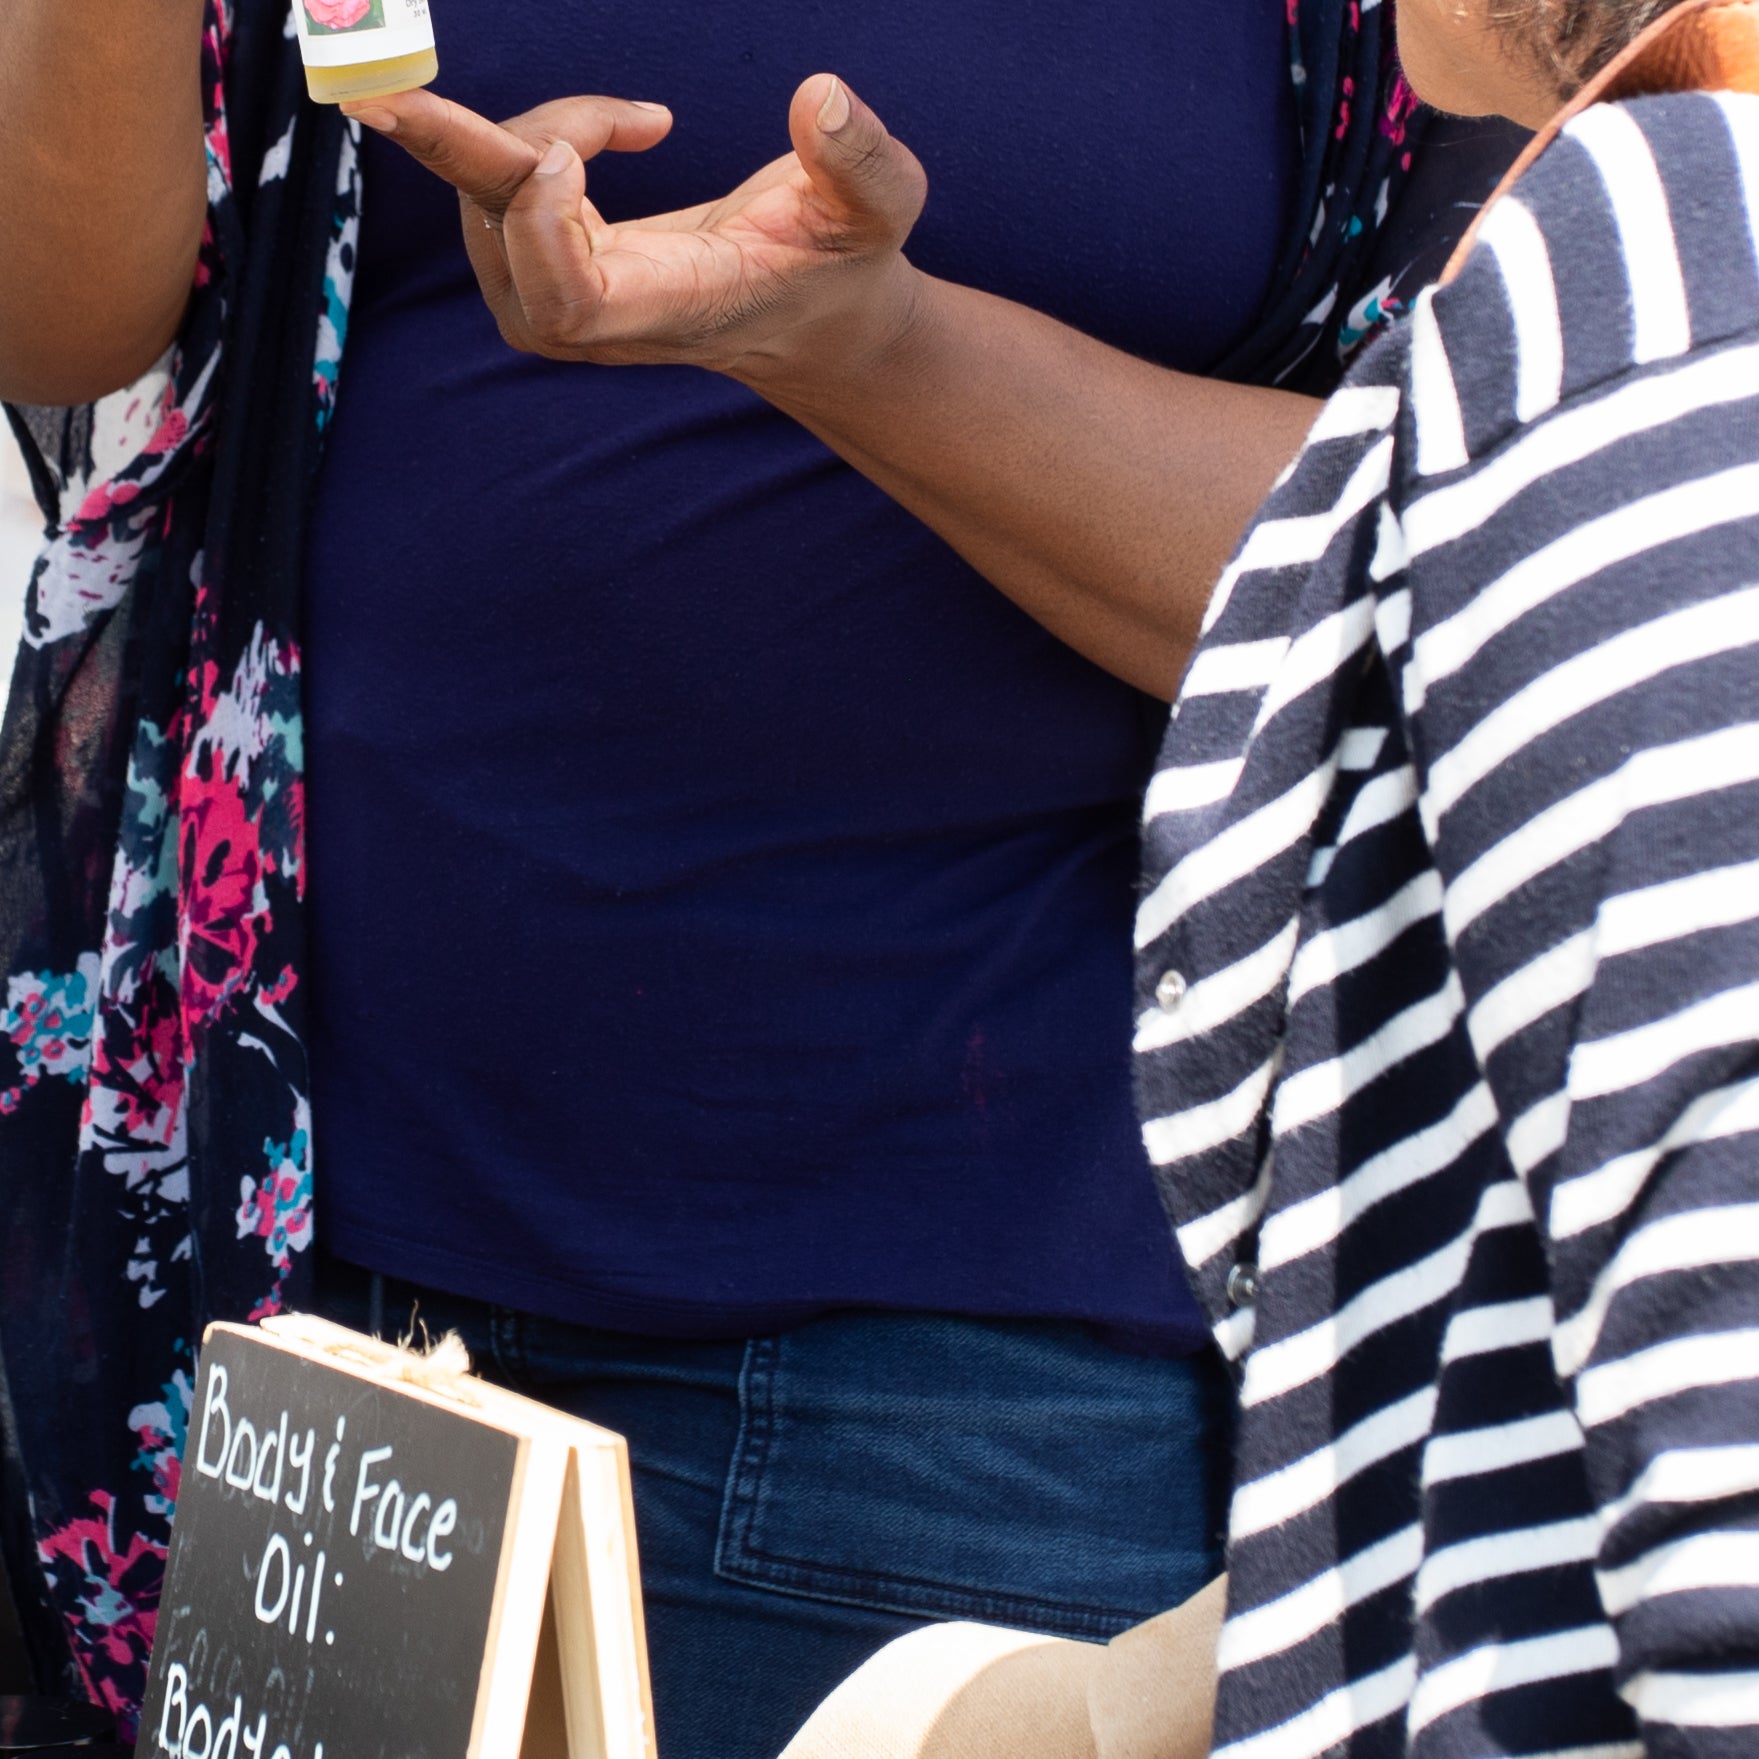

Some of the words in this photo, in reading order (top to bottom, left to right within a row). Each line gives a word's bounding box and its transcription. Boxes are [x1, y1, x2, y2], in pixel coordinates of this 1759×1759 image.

[196, 1361, 315, 1516] Body
[349, 1444, 458, 1573] Face
[253, 1531, 345, 1646] Oil:
